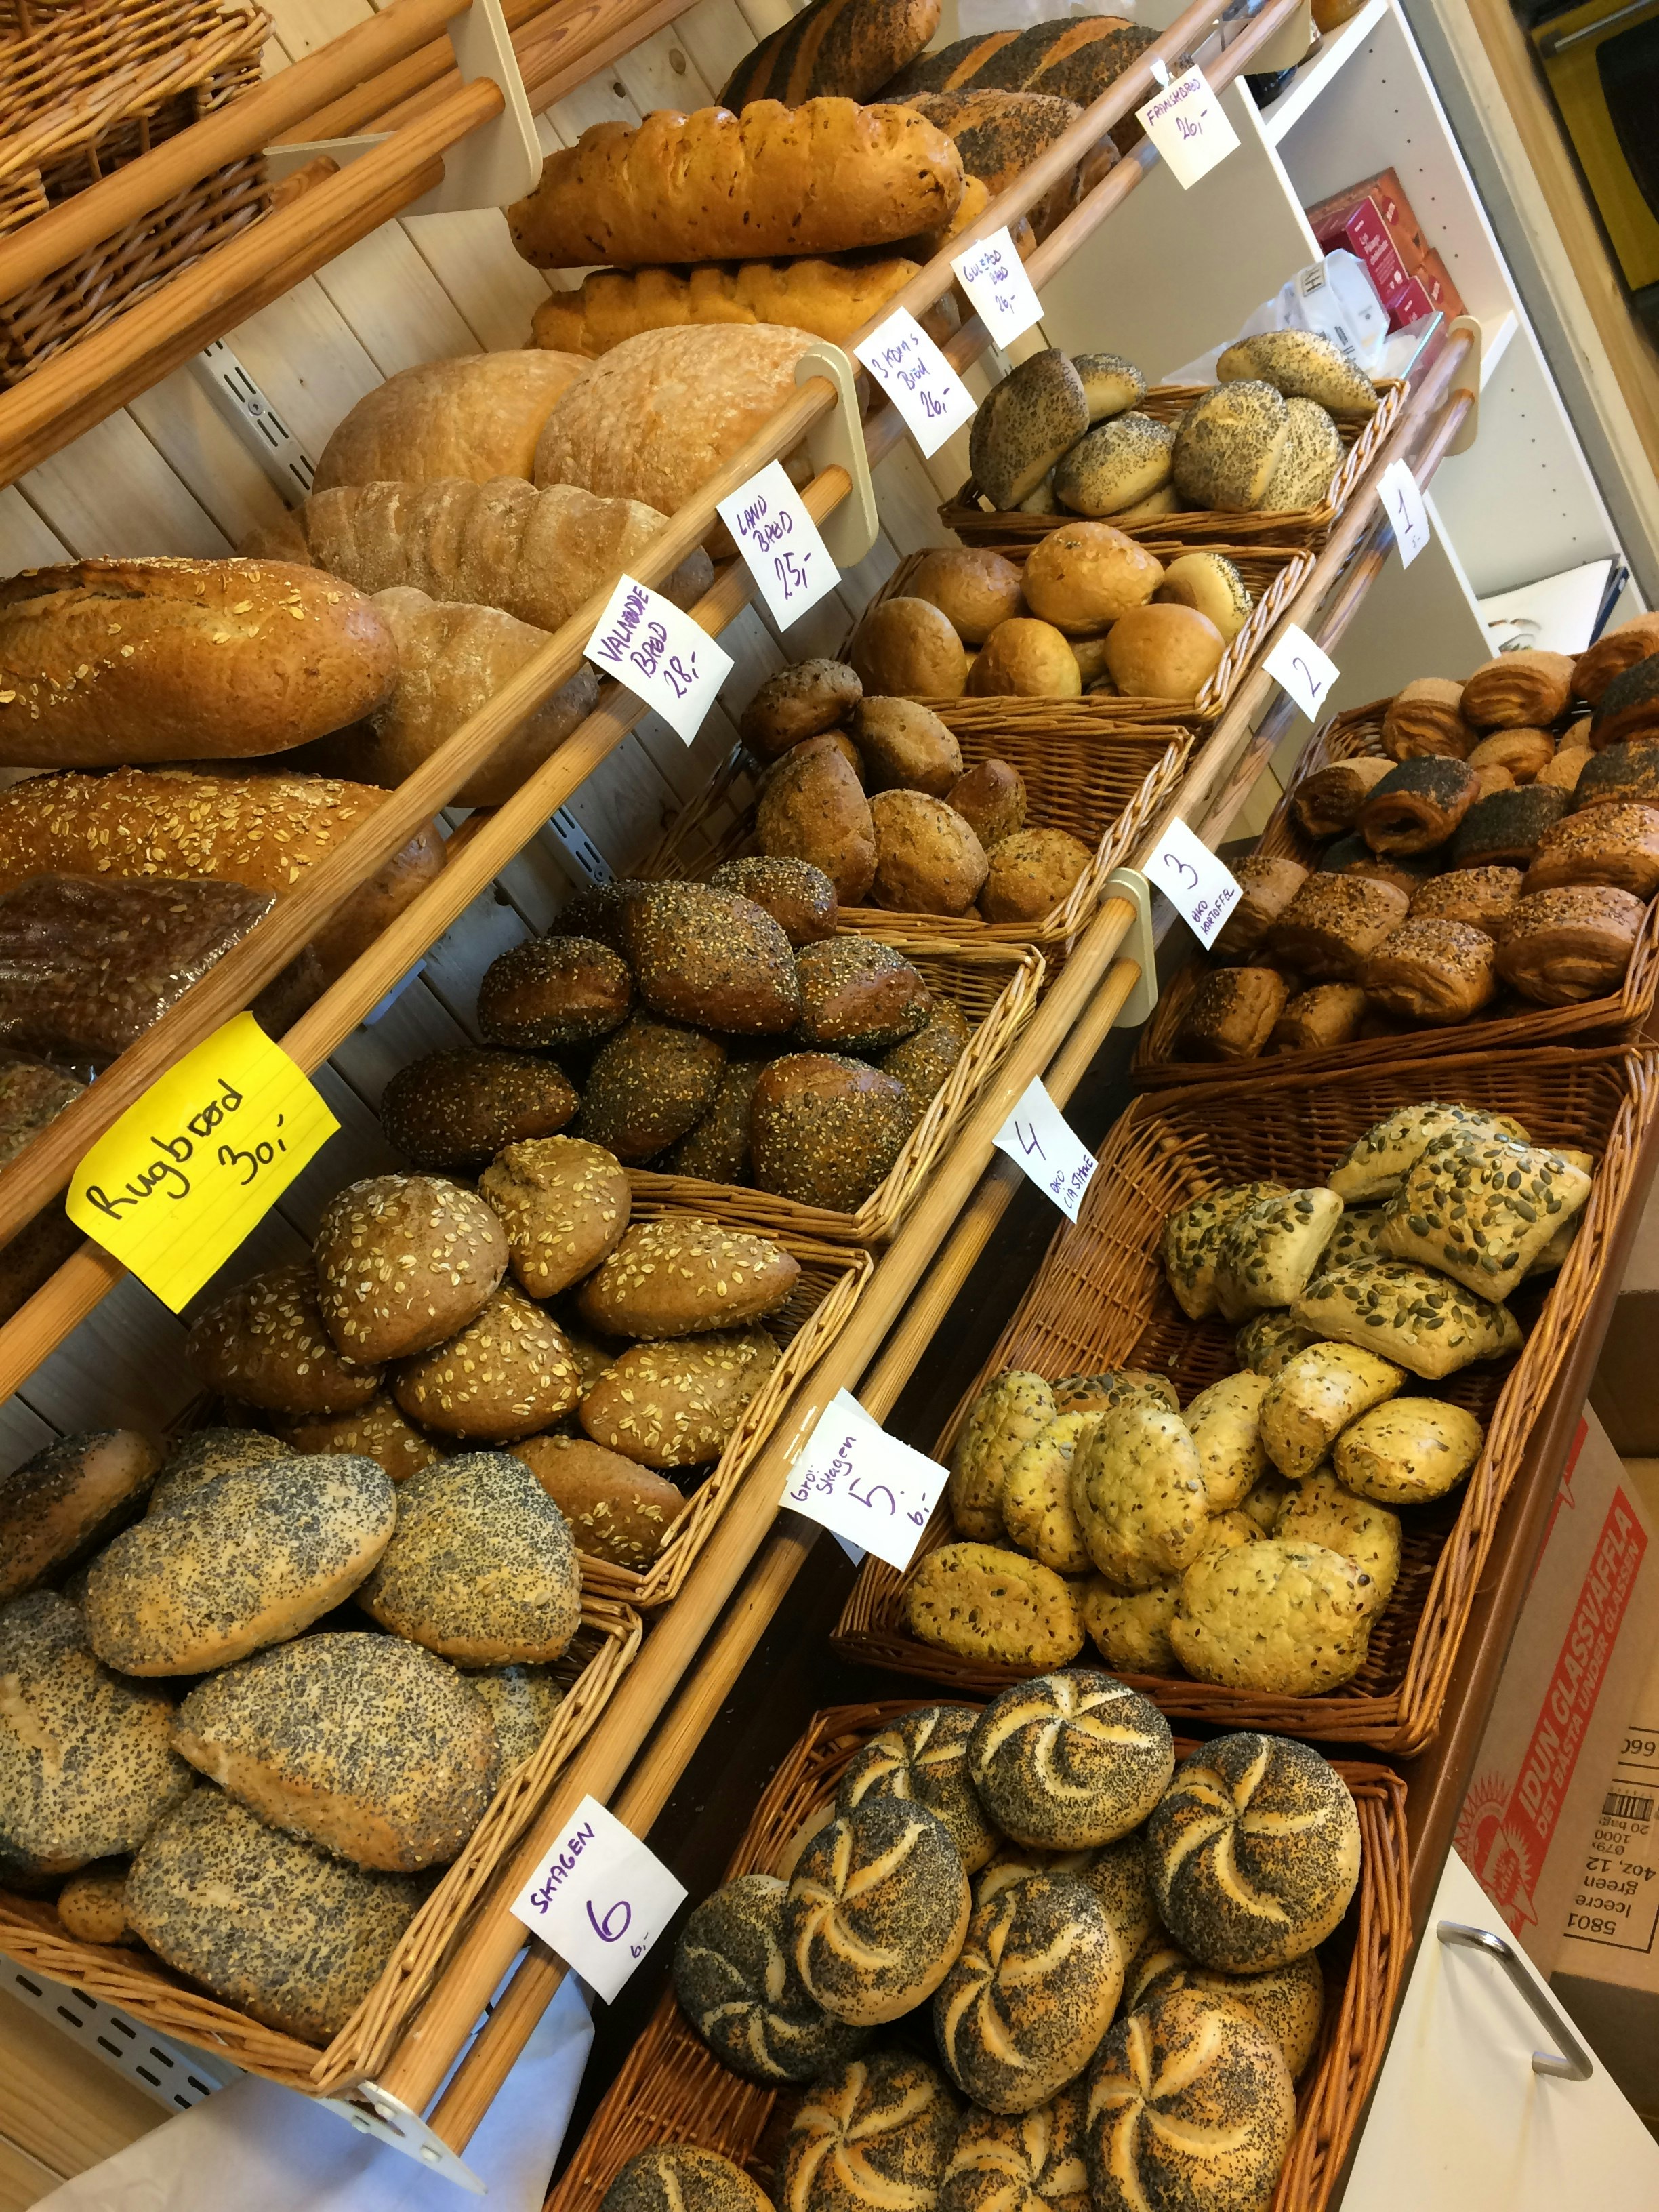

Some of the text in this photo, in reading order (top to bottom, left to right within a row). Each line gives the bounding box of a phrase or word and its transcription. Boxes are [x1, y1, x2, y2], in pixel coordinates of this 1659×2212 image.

[872, 359, 888, 378] 3
[737, 495, 767, 535] LAND
[1397, 489, 1414, 534] 1
[1292, 657, 1322, 698] 2
[1164, 853, 1198, 890] 3
[1200, 888, 1235, 935] KARTOFFEL
[1015, 1120, 1047, 1161] 4
[1519, 1718, 1560, 1821] IDUN
[1552, 1506, 1633, 1725] GLASSVÄFFLA
[1536, 1786, 1557, 1839] DET
[1578, 1632, 1609, 1711] UNDER
[1603, 1538, 1639, 1634] GLASSEN
[1595, 1829, 1631, 1843] 1000
[1631, 1822, 1650, 1835] 20
[530, 1822, 595, 1914] SKAGEN
[1584, 1875, 1639, 1896] green
[1586, 1856, 1657, 1881] 4oz, 12
[586, 1900, 632, 1942] 6
[1567, 1912, 1617, 1936] 5801
[1575, 1894, 1631, 1918] Icecre
